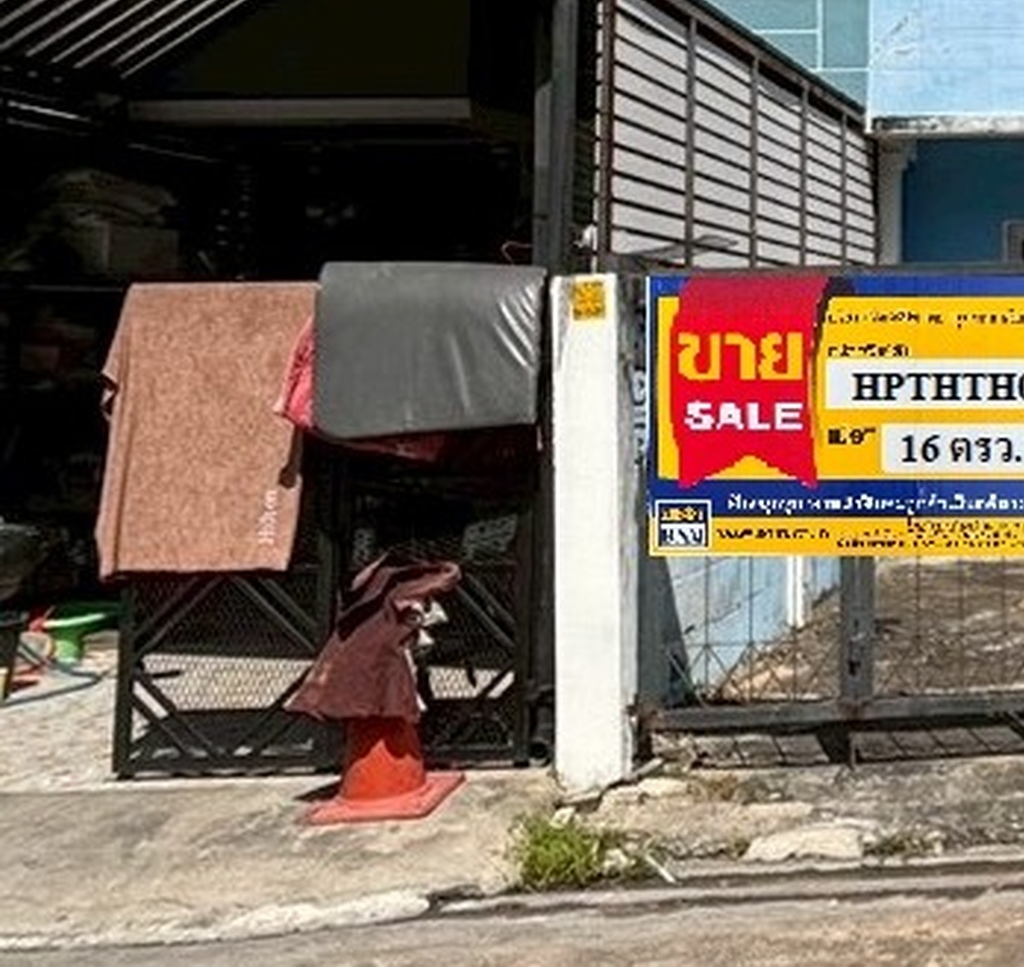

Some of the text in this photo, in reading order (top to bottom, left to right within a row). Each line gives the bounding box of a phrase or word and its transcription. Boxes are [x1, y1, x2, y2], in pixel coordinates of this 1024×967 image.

[678, 331, 803, 380] ขาย
[684, 400, 803, 431] SALE
[901, 434, 940, 463] 16
